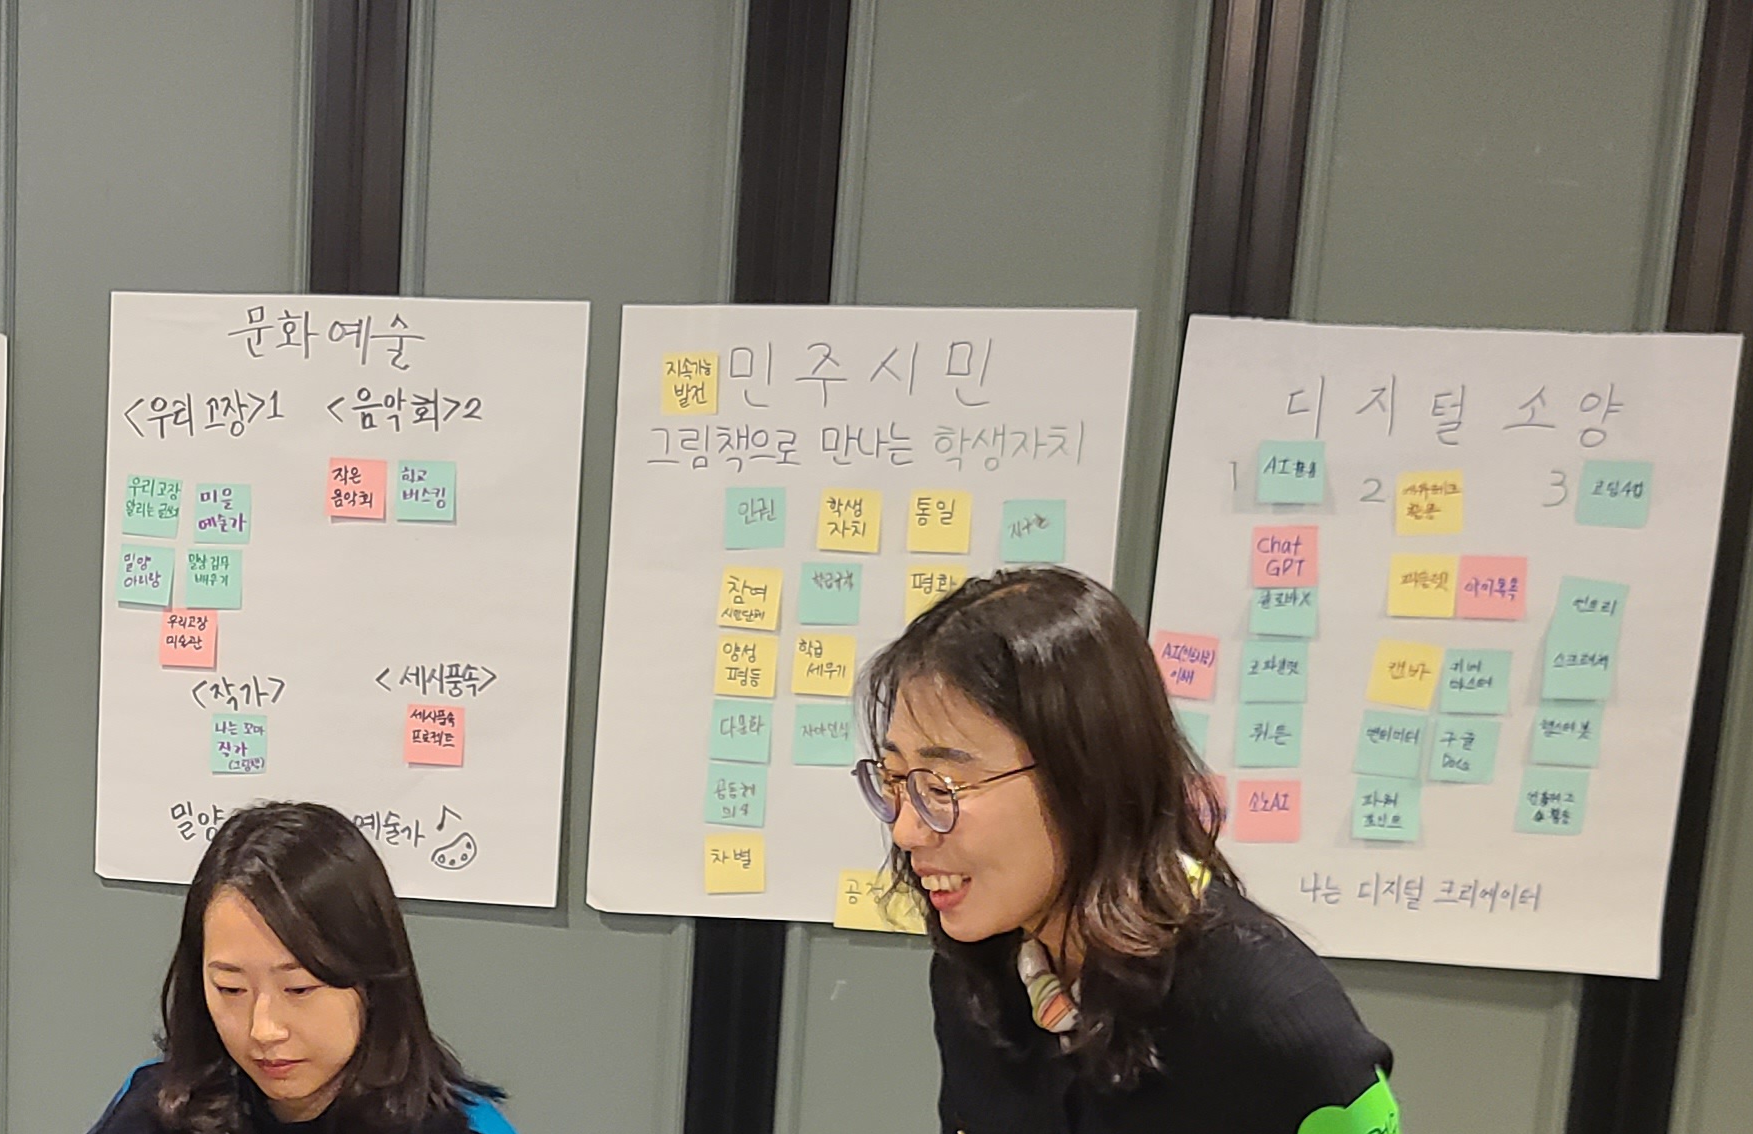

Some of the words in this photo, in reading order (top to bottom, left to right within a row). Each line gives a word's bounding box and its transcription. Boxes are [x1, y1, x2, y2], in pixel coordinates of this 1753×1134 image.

[674, 384, 707, 408] 발전
[647, 424, 801, 472] 그림책으로
[821, 422, 914, 466] 만나는
[331, 466, 362, 485] 작은
[403, 488, 447, 510] 버스킹
[1359, 478, 1386, 503] 2
[1542, 470, 1568, 507] 3
[330, 490, 374, 509] 음악회
[827, 497, 863, 517] 학생
[738, 498, 777, 524] 인권
[915, 497, 955, 526] 통일
[827, 520, 866, 537] 자치
[1257, 535, 1304, 556] Chat
[1266, 559, 1306, 577] GPT
[727, 575, 768, 604] 참여
[722, 642, 757, 663] 양성
[799, 638, 824, 658] 학급
[725, 666, 762, 687] 평등
[806, 662, 847, 680] 세우기
[1388, 661, 1432, 681] 캔바
[719, 714, 765, 738] 다문화
[710, 849, 752, 869] 차별
[1300, 872, 1342, 905] 나는
[1357, 872, 1424, 911] 디지털
[1433, 878, 1543, 913] 크리에이터
